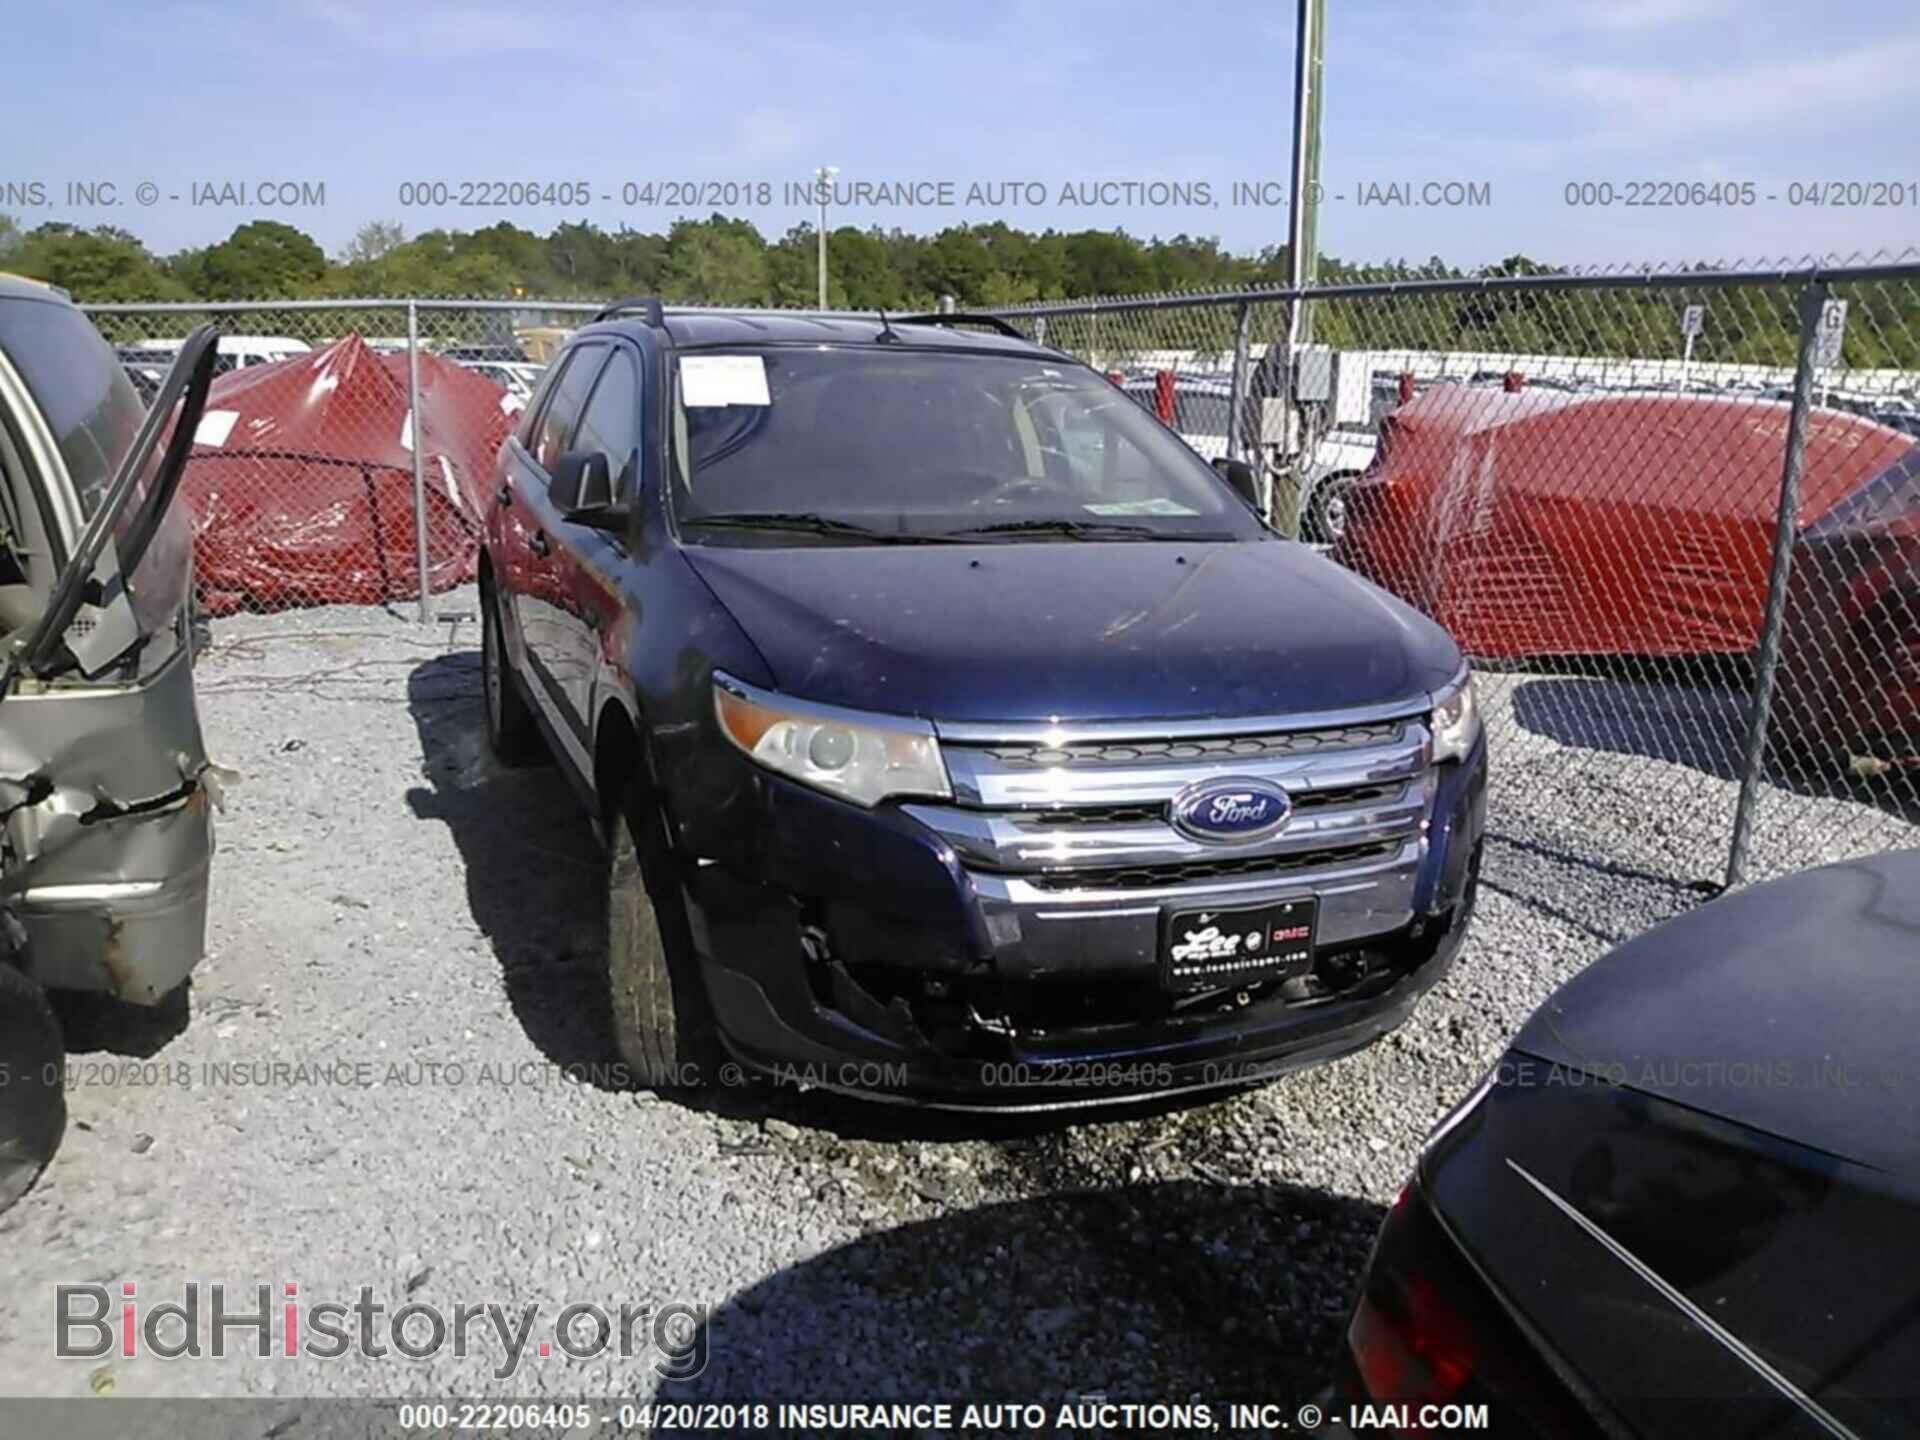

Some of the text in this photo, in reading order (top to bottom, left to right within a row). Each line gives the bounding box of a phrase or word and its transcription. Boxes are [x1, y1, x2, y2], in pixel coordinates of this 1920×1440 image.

[1209, 794, 1268, 823] Ford
[1171, 926, 1241, 961] Lee
[1272, 925, 1310, 941] GMC
